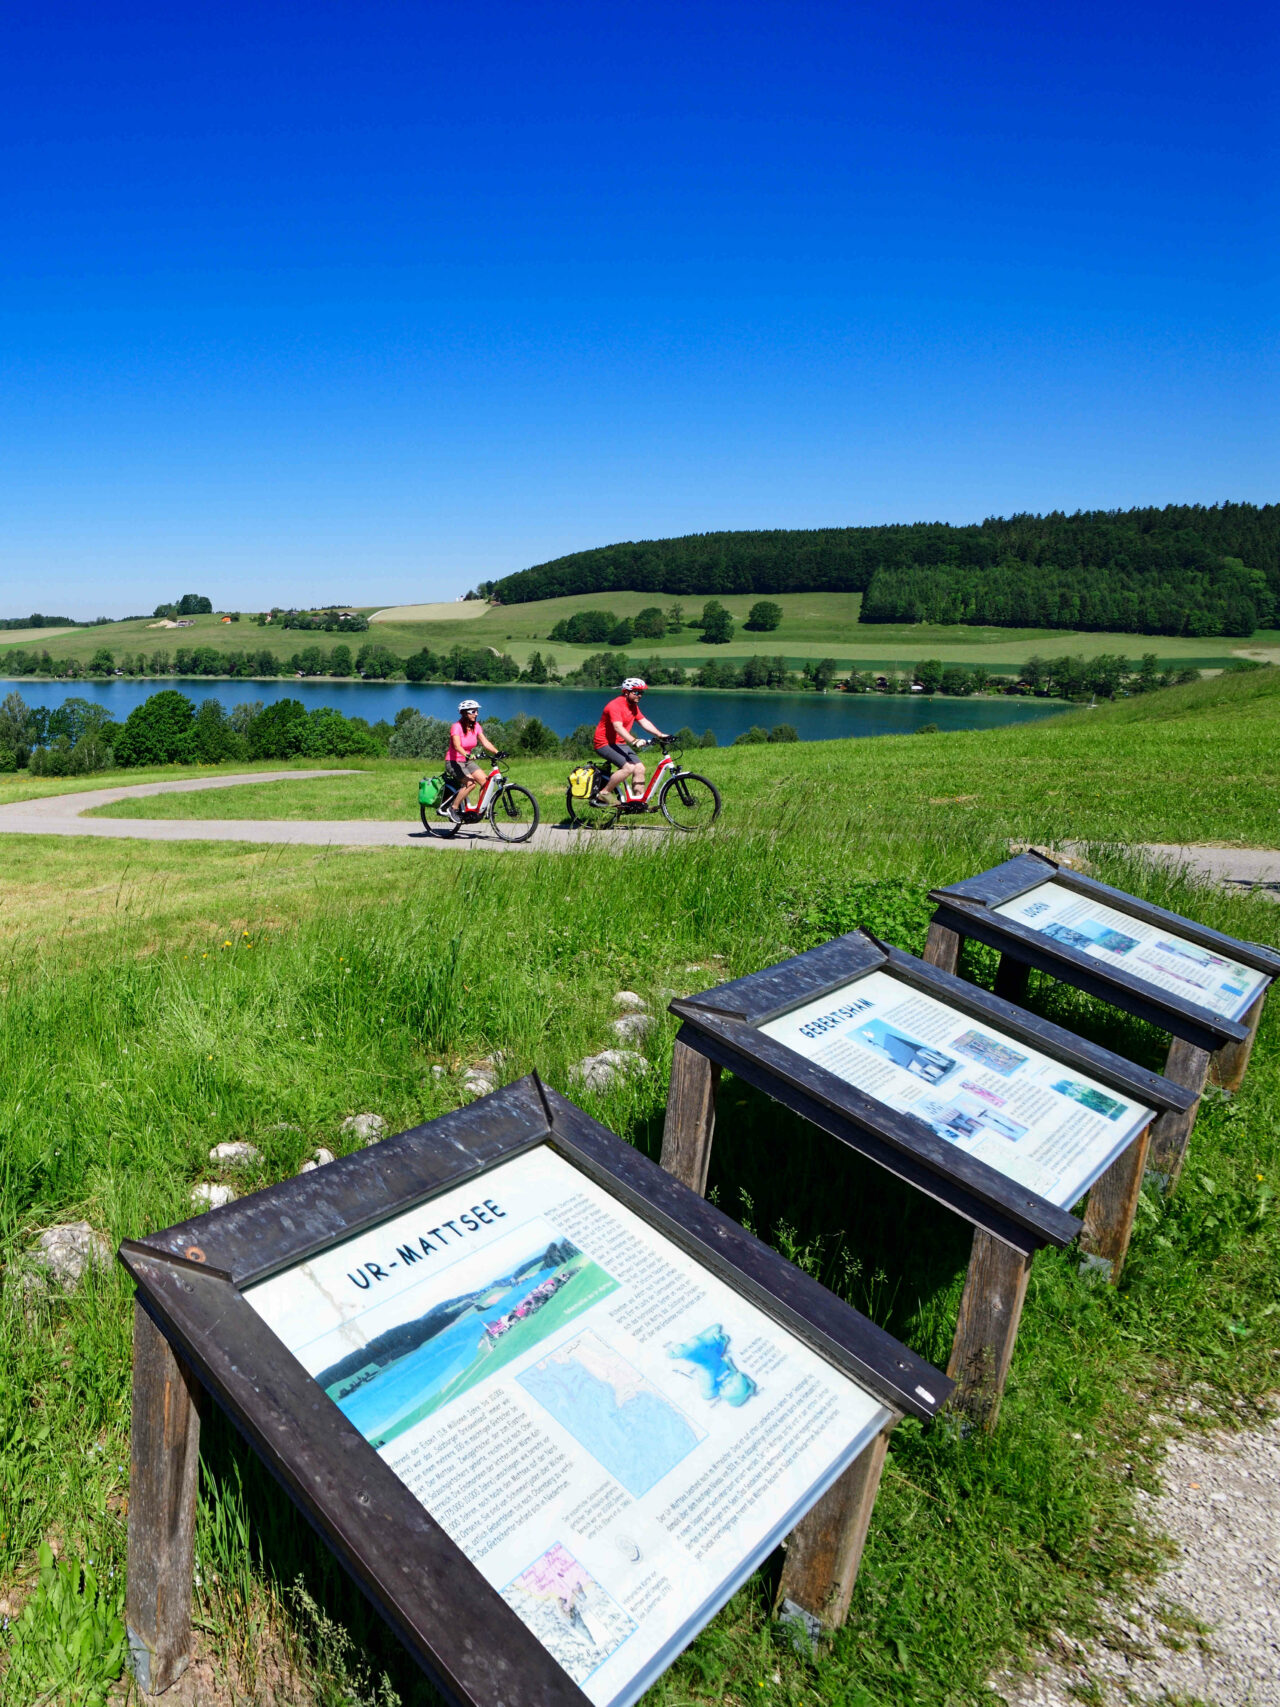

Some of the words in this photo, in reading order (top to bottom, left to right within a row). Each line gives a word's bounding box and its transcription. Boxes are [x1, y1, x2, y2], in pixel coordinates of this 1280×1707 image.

[799, 997, 876, 1039] GEBERTSHAM
[347, 1199, 506, 1290] UR-MATTSEE
[398, 1465, 413, 1478] ahre)
